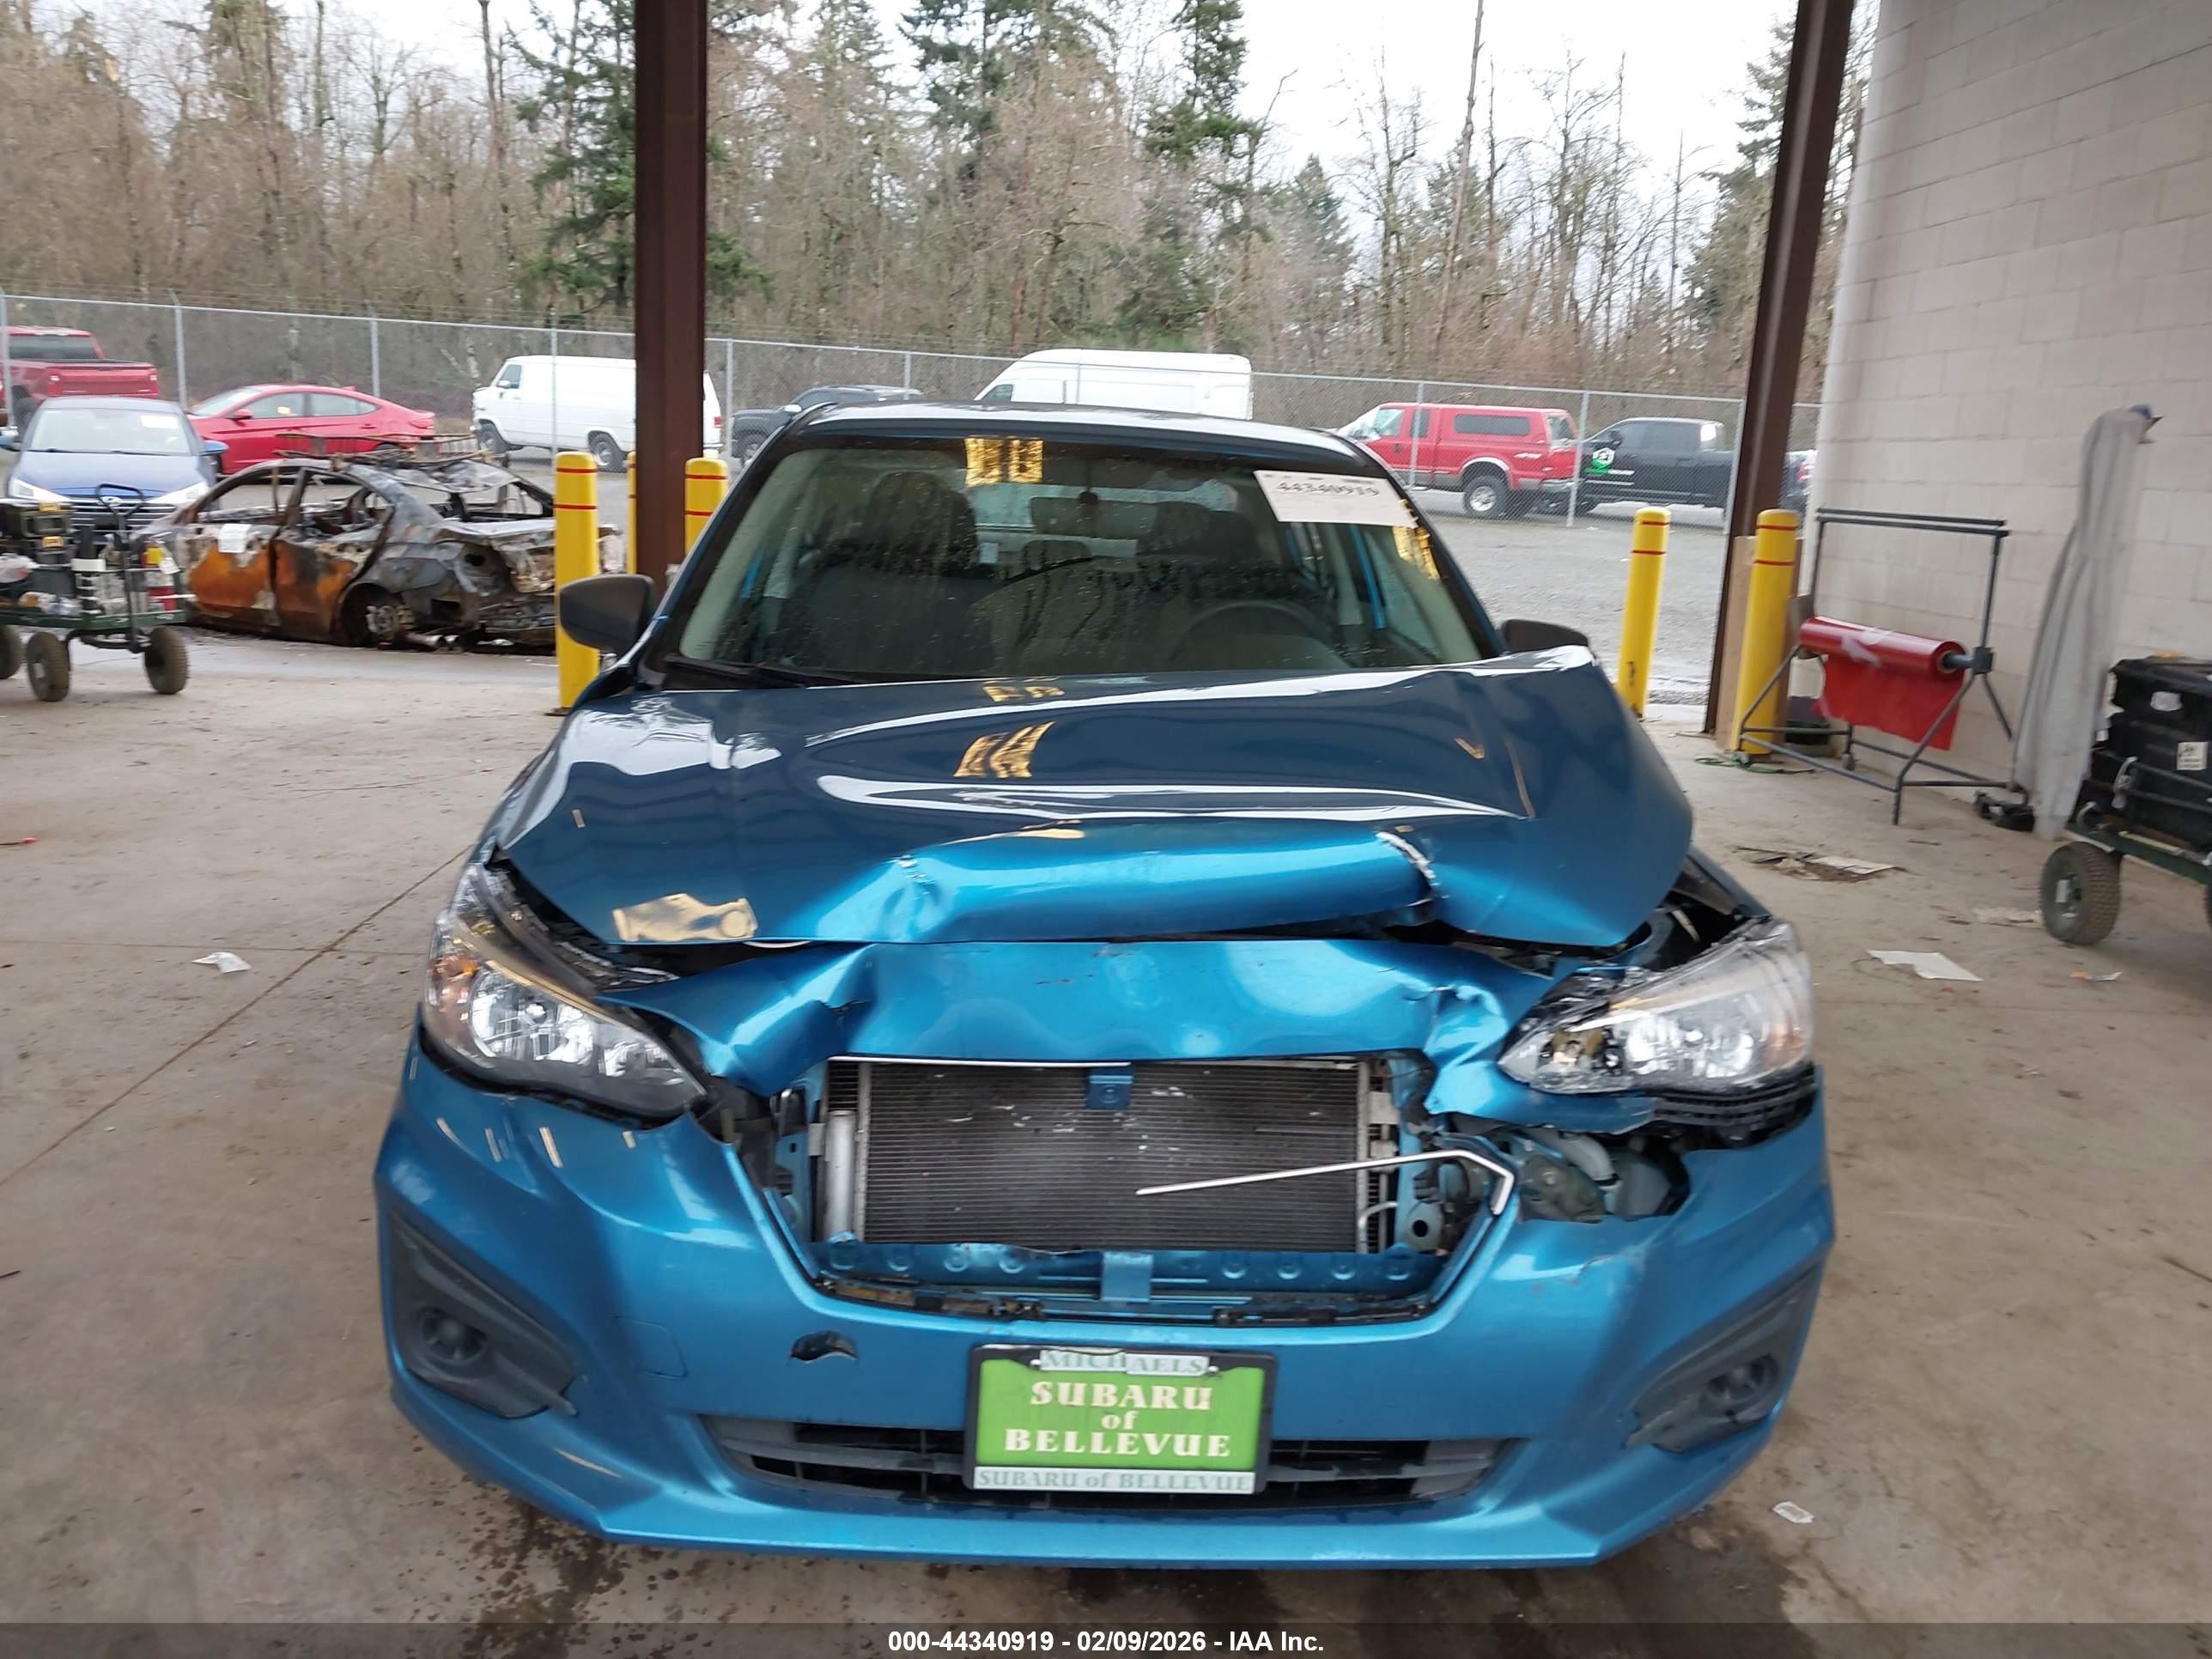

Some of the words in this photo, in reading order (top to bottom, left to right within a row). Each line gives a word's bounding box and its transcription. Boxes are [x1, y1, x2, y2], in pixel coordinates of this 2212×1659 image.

[1042, 1351, 1204, 1374] MICHAELS
[1030, 1381, 1213, 1410] SUBARU
[1101, 1410, 1139, 1431] of
[1005, 1428, 1231, 1457] BELLEVUE
[978, 1470, 1076, 1487] SUBARU
[1085, 1471, 1110, 1489] of
[1120, 1473, 1250, 1491] BELLEVUE
